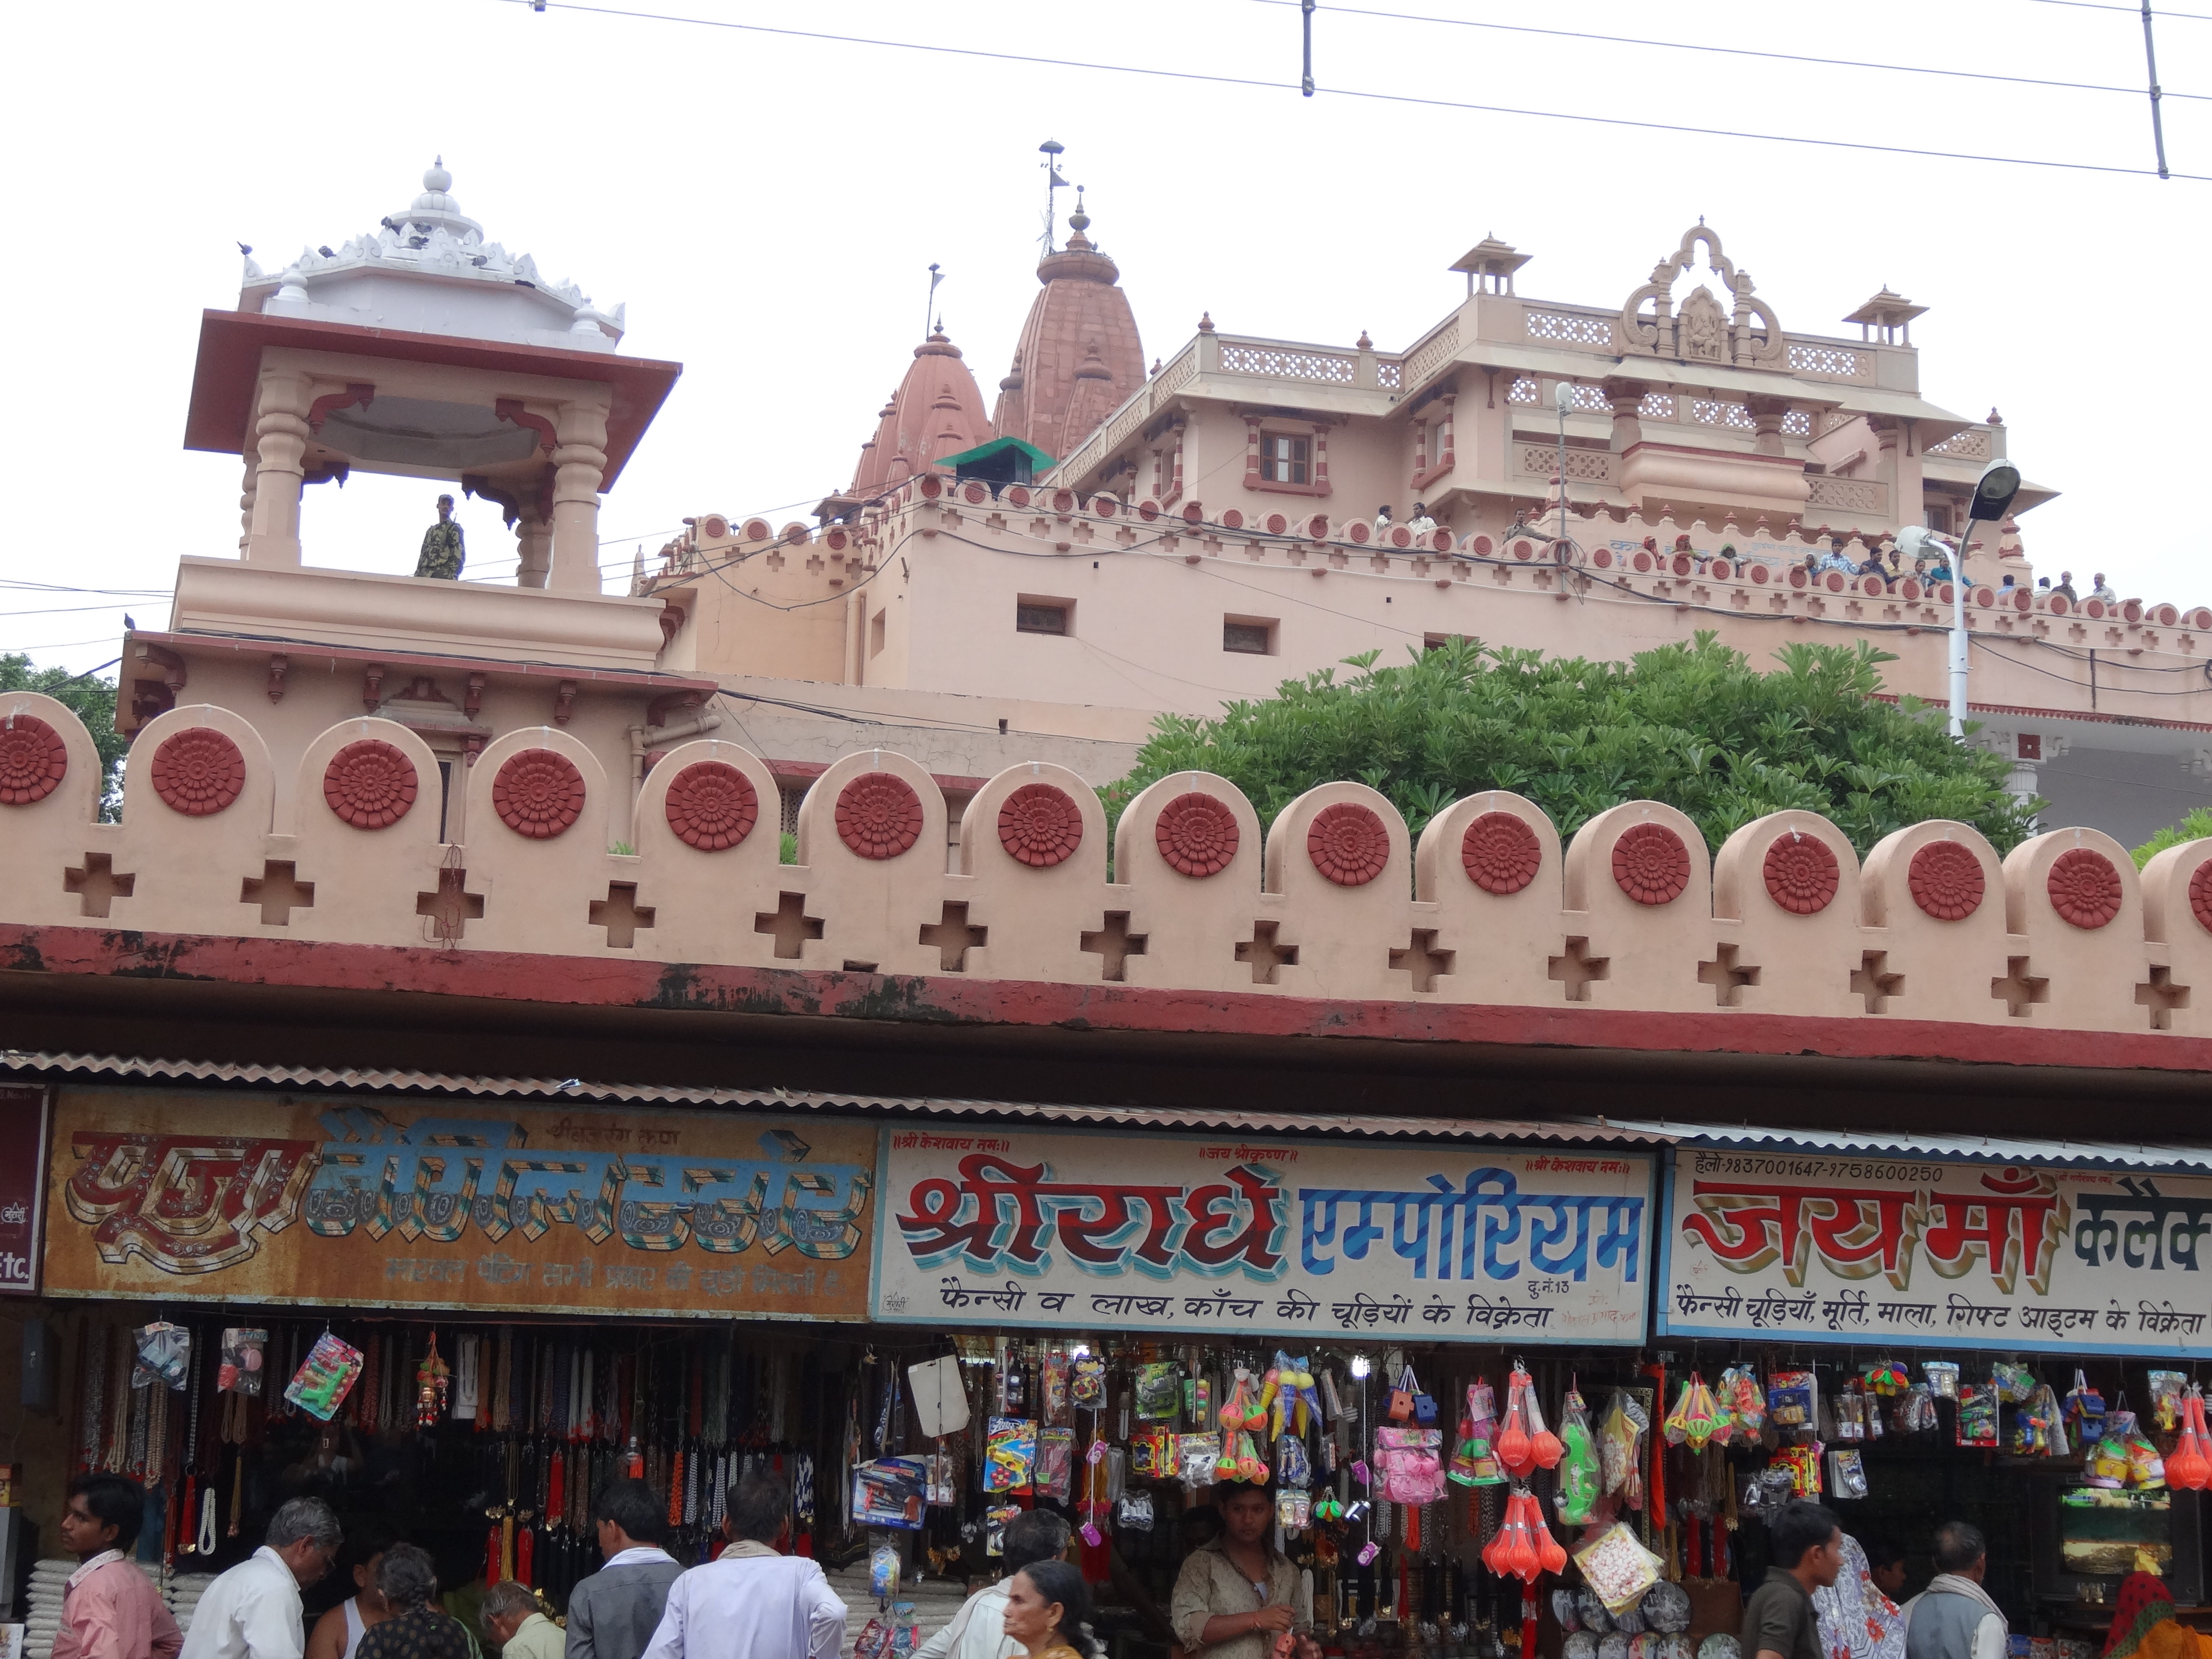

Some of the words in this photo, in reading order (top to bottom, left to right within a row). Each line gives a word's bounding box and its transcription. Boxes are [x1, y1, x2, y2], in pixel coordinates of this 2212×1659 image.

[920, 1132, 974, 1150] केशवाय
[1551, 1157, 1598, 1173] केशवाय
[65, 1131, 323, 1275] पूजा
[1299, 1167, 1645, 1283] एम्पोरियम
[1682, 1179, 1928, 1291] जय
[1038, 1293, 1076, 1310] व
[1277, 1289, 1329, 1324] की
[1423, 1295, 1461, 1324] के
[1466, 1296, 1556, 1330] विक्रेता
[1946, 1293, 2012, 1328] गिफ्ट
[2018, 1305, 2099, 1338] आइटम
[2105, 1298, 2130, 1330] के
[2138, 1300, 2208, 1336] विक्रेता
